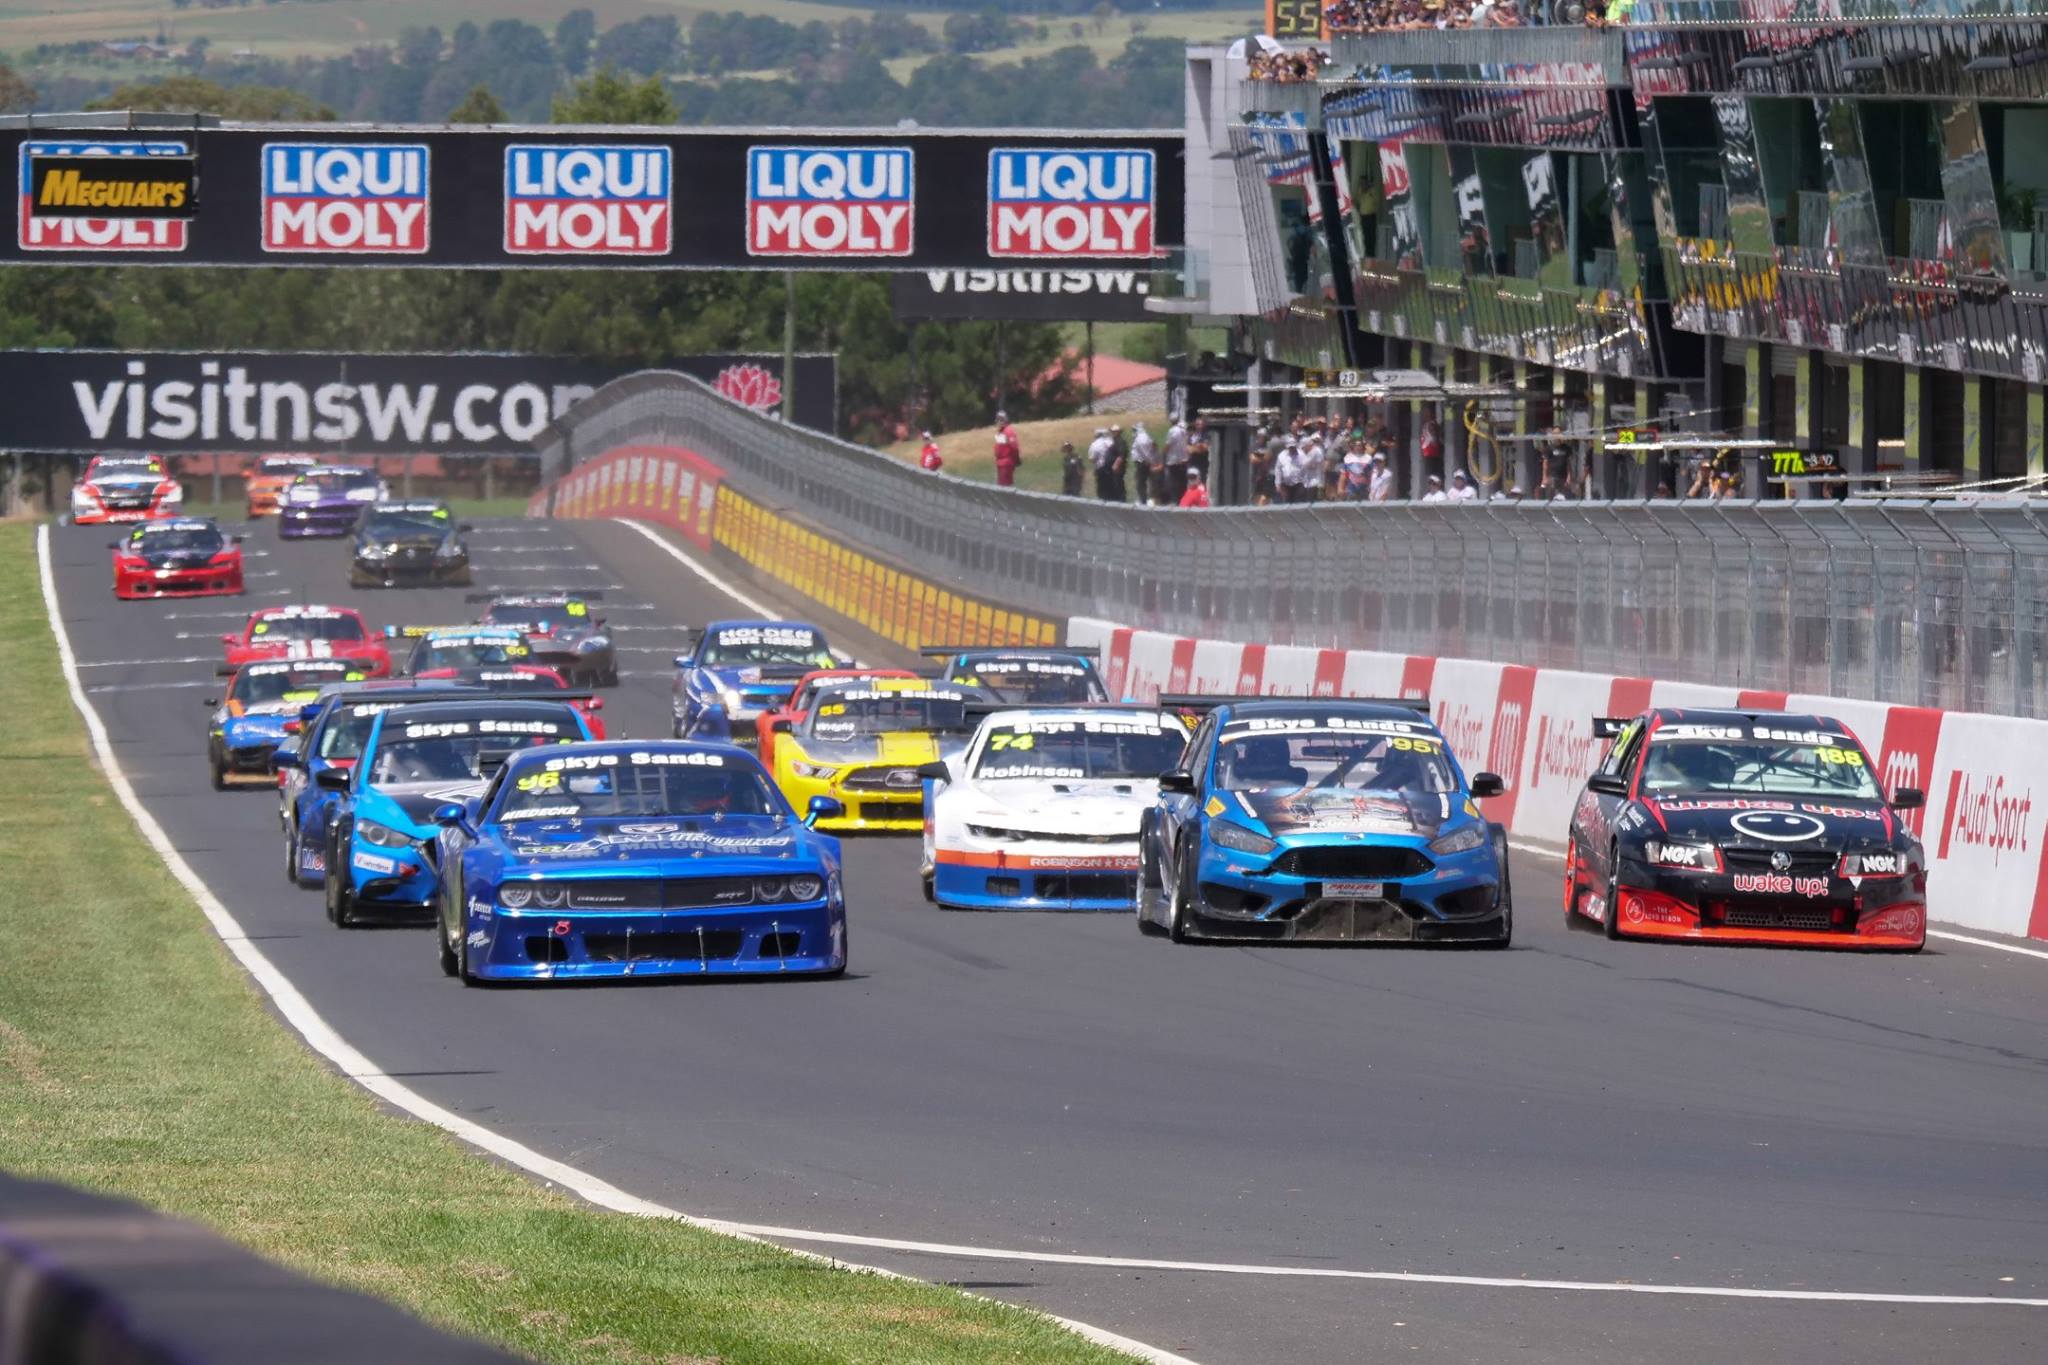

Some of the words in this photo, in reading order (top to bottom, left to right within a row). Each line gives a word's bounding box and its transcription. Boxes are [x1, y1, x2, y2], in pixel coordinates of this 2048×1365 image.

[1277, 1, 1319, 32] 55
[271, 150, 421, 199] LIQUI
[514, 152, 662, 200] LIQUI
[756, 153, 905, 201] LIQUI
[1000, 154, 1148, 202] LIQUI
[271, 203, 426, 247] MOLY
[514, 204, 666, 248] MOLY
[756, 205, 909, 250] MOLY
[999, 206, 1150, 251] MOLY
[405, 722, 470, 738] Skye
[479, 720, 558, 735] Sands
[1013, 722, 1075, 735] Skye
[1085, 722, 1163, 736] Sands
[1249, 718, 1315, 731] Skye
[1327, 717, 1412, 733] Sands
[991, 734, 1034, 751] 74
[1677, 727, 1743, 739] Skye
[1752, 727, 1834, 745] Sands
[545, 754, 619, 772] Skye
[630, 752, 723, 767] Sands
[1814, 747, 1863, 766] 188
[978, 765, 1084, 779] Robinson
[501, 805, 580, 822] MIEDECKE
[1954, 773, 1993, 846] Audi
[1988, 775, 2031, 868] Sport
[1030, 857, 1102, 867] ROBINSON
[1660, 845, 1699, 865] NGK
[1862, 854, 1896, 873] NGK
[1733, 873, 1792, 892] wake
[1795, 876, 1829, 899] up!
